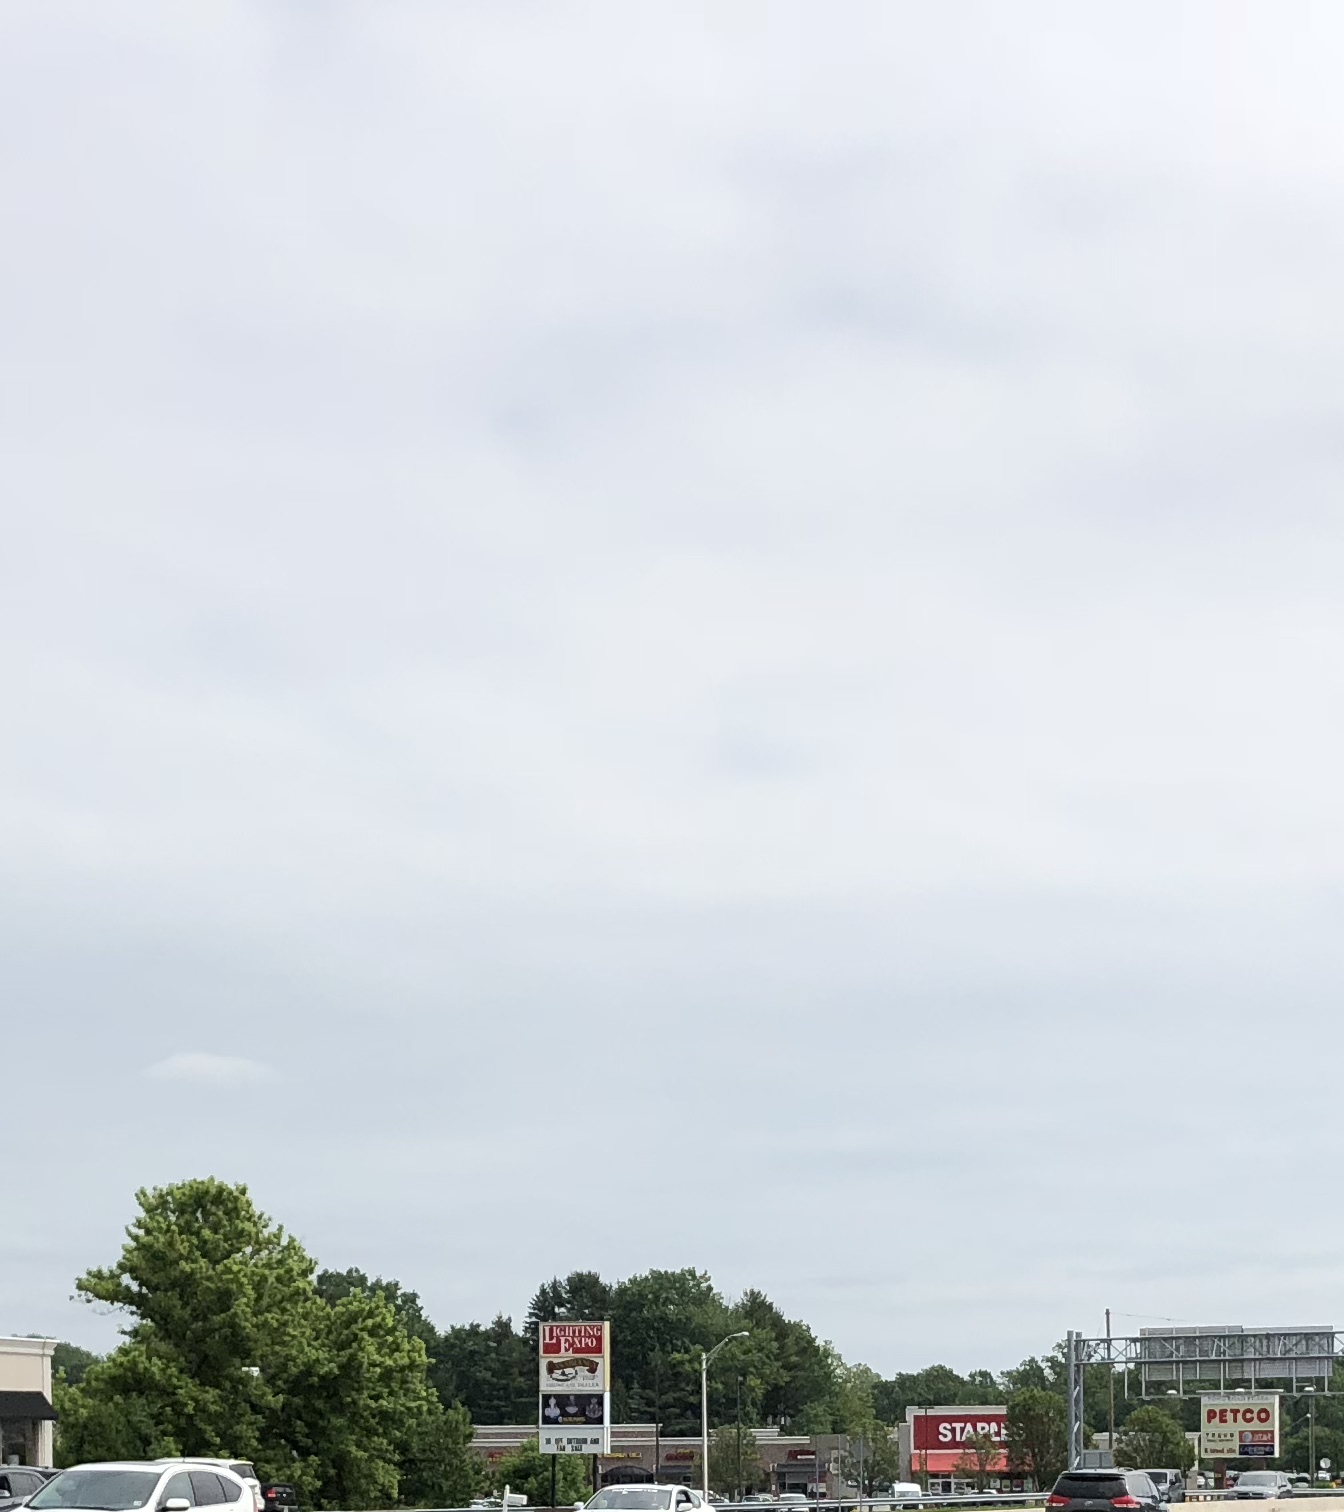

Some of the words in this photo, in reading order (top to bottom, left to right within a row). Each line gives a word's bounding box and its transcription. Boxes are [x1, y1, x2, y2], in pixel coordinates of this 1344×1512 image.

[543, 1325, 602, 1343] LIGHTING
[559, 1336, 596, 1355] EXPO
[1206, 1407, 1271, 1424] PETCO
